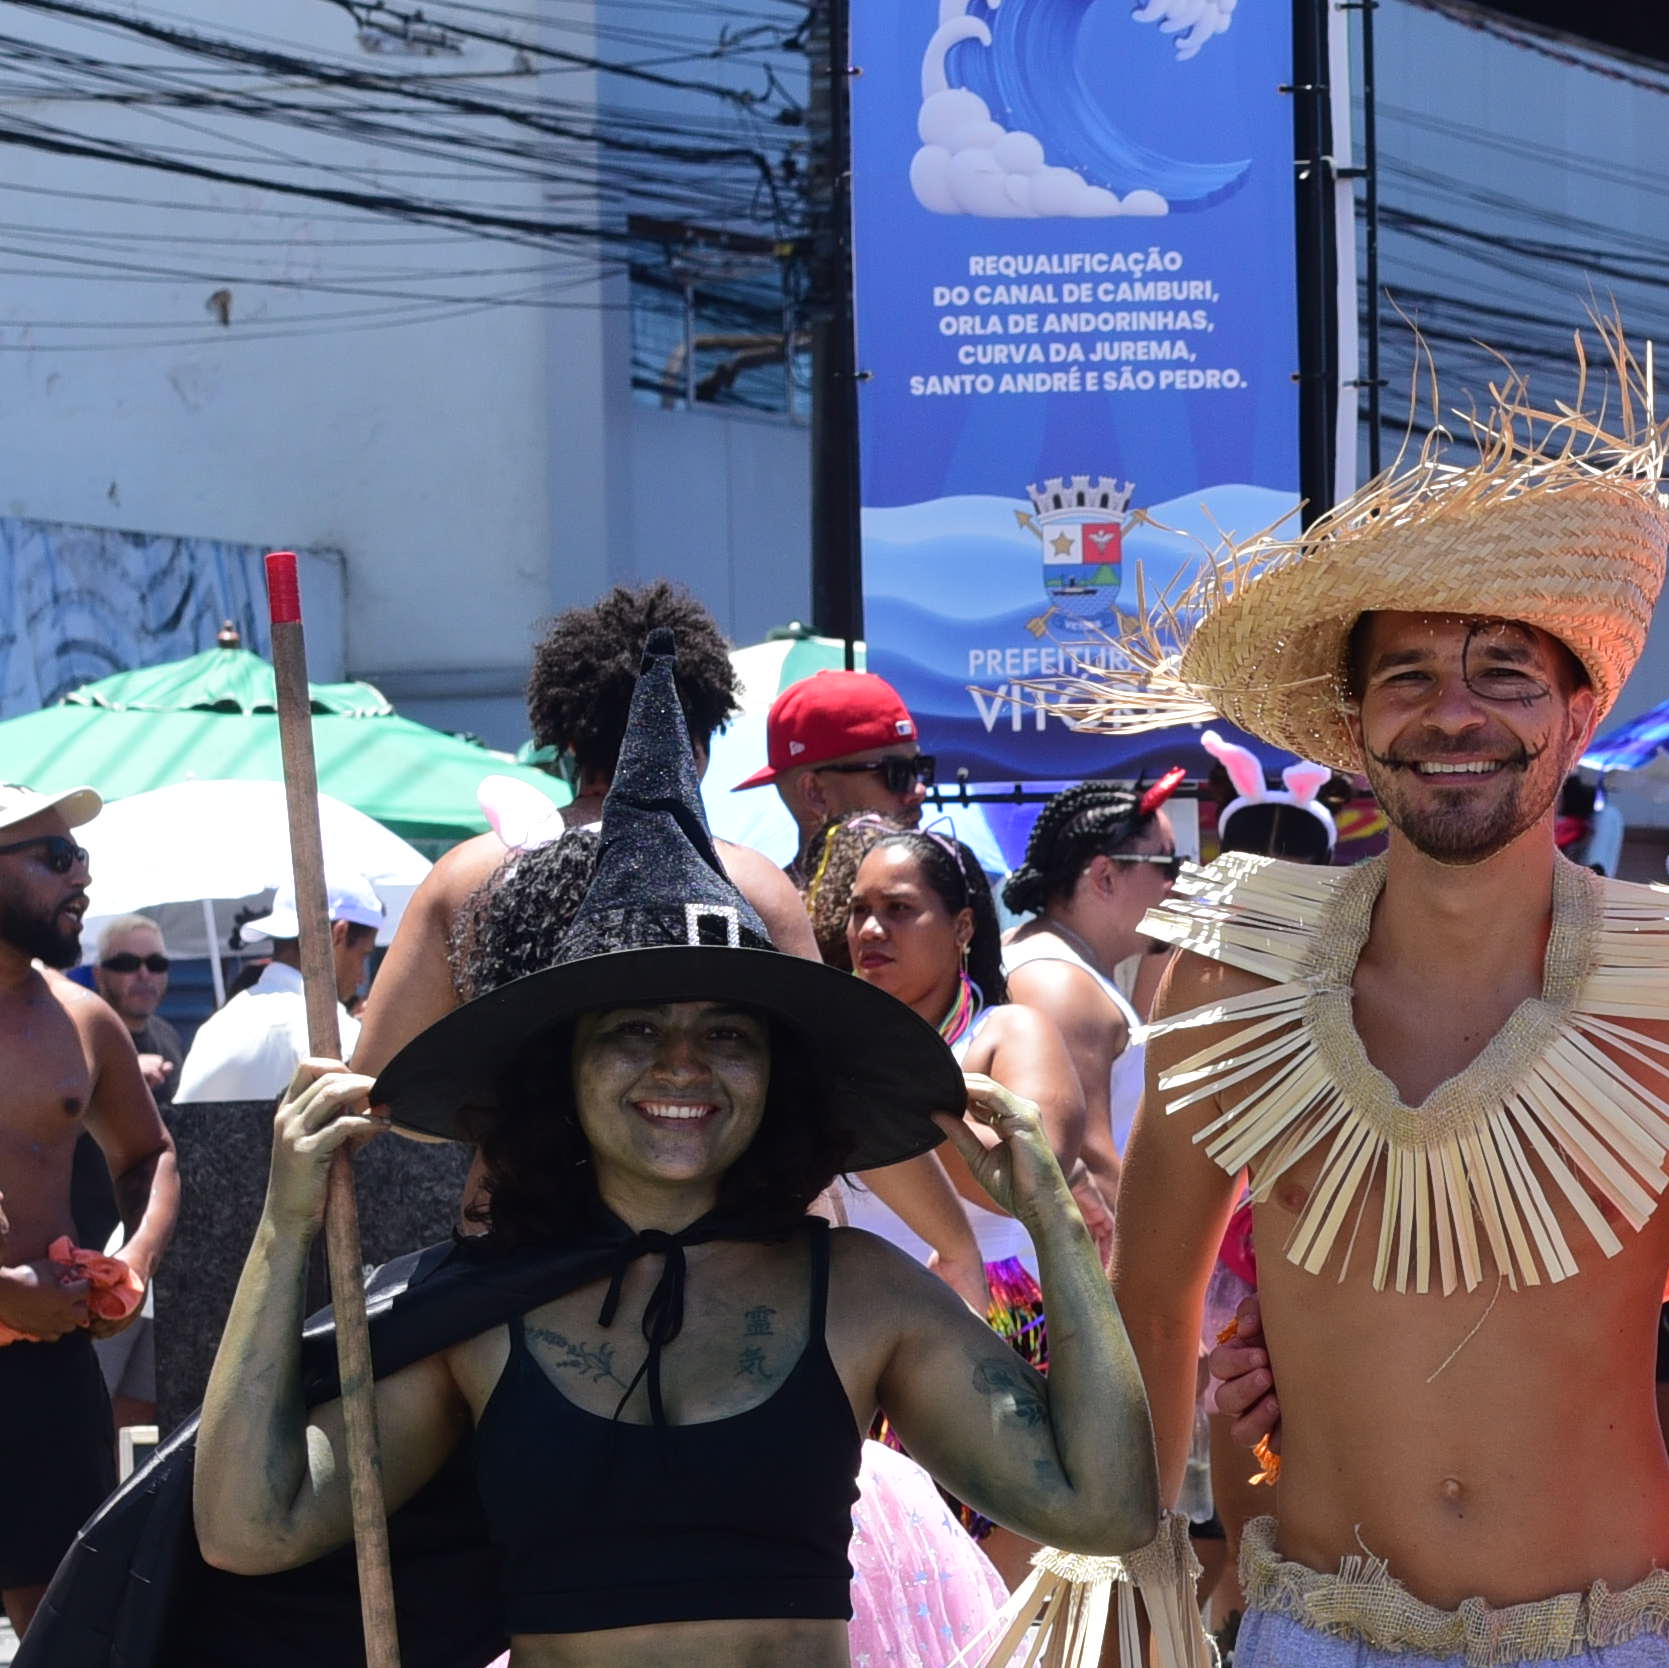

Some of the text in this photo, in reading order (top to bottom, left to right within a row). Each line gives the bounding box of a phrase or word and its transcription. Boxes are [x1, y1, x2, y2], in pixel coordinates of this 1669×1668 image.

[969, 247, 1183, 278] REQUALIFICAÇÃO
[933, 279, 1219, 307] DO CANAL DE CAMBURI,
[939, 309, 1215, 336] ORLA DE ANDORINHAS,
[958, 340, 1197, 365] CURVA DA JUREMA,
[910, 365, 1248, 396] SANTO ANDRÉ E SÃO PEDRO.
[969, 647, 1143, 677] PREFEITUR
